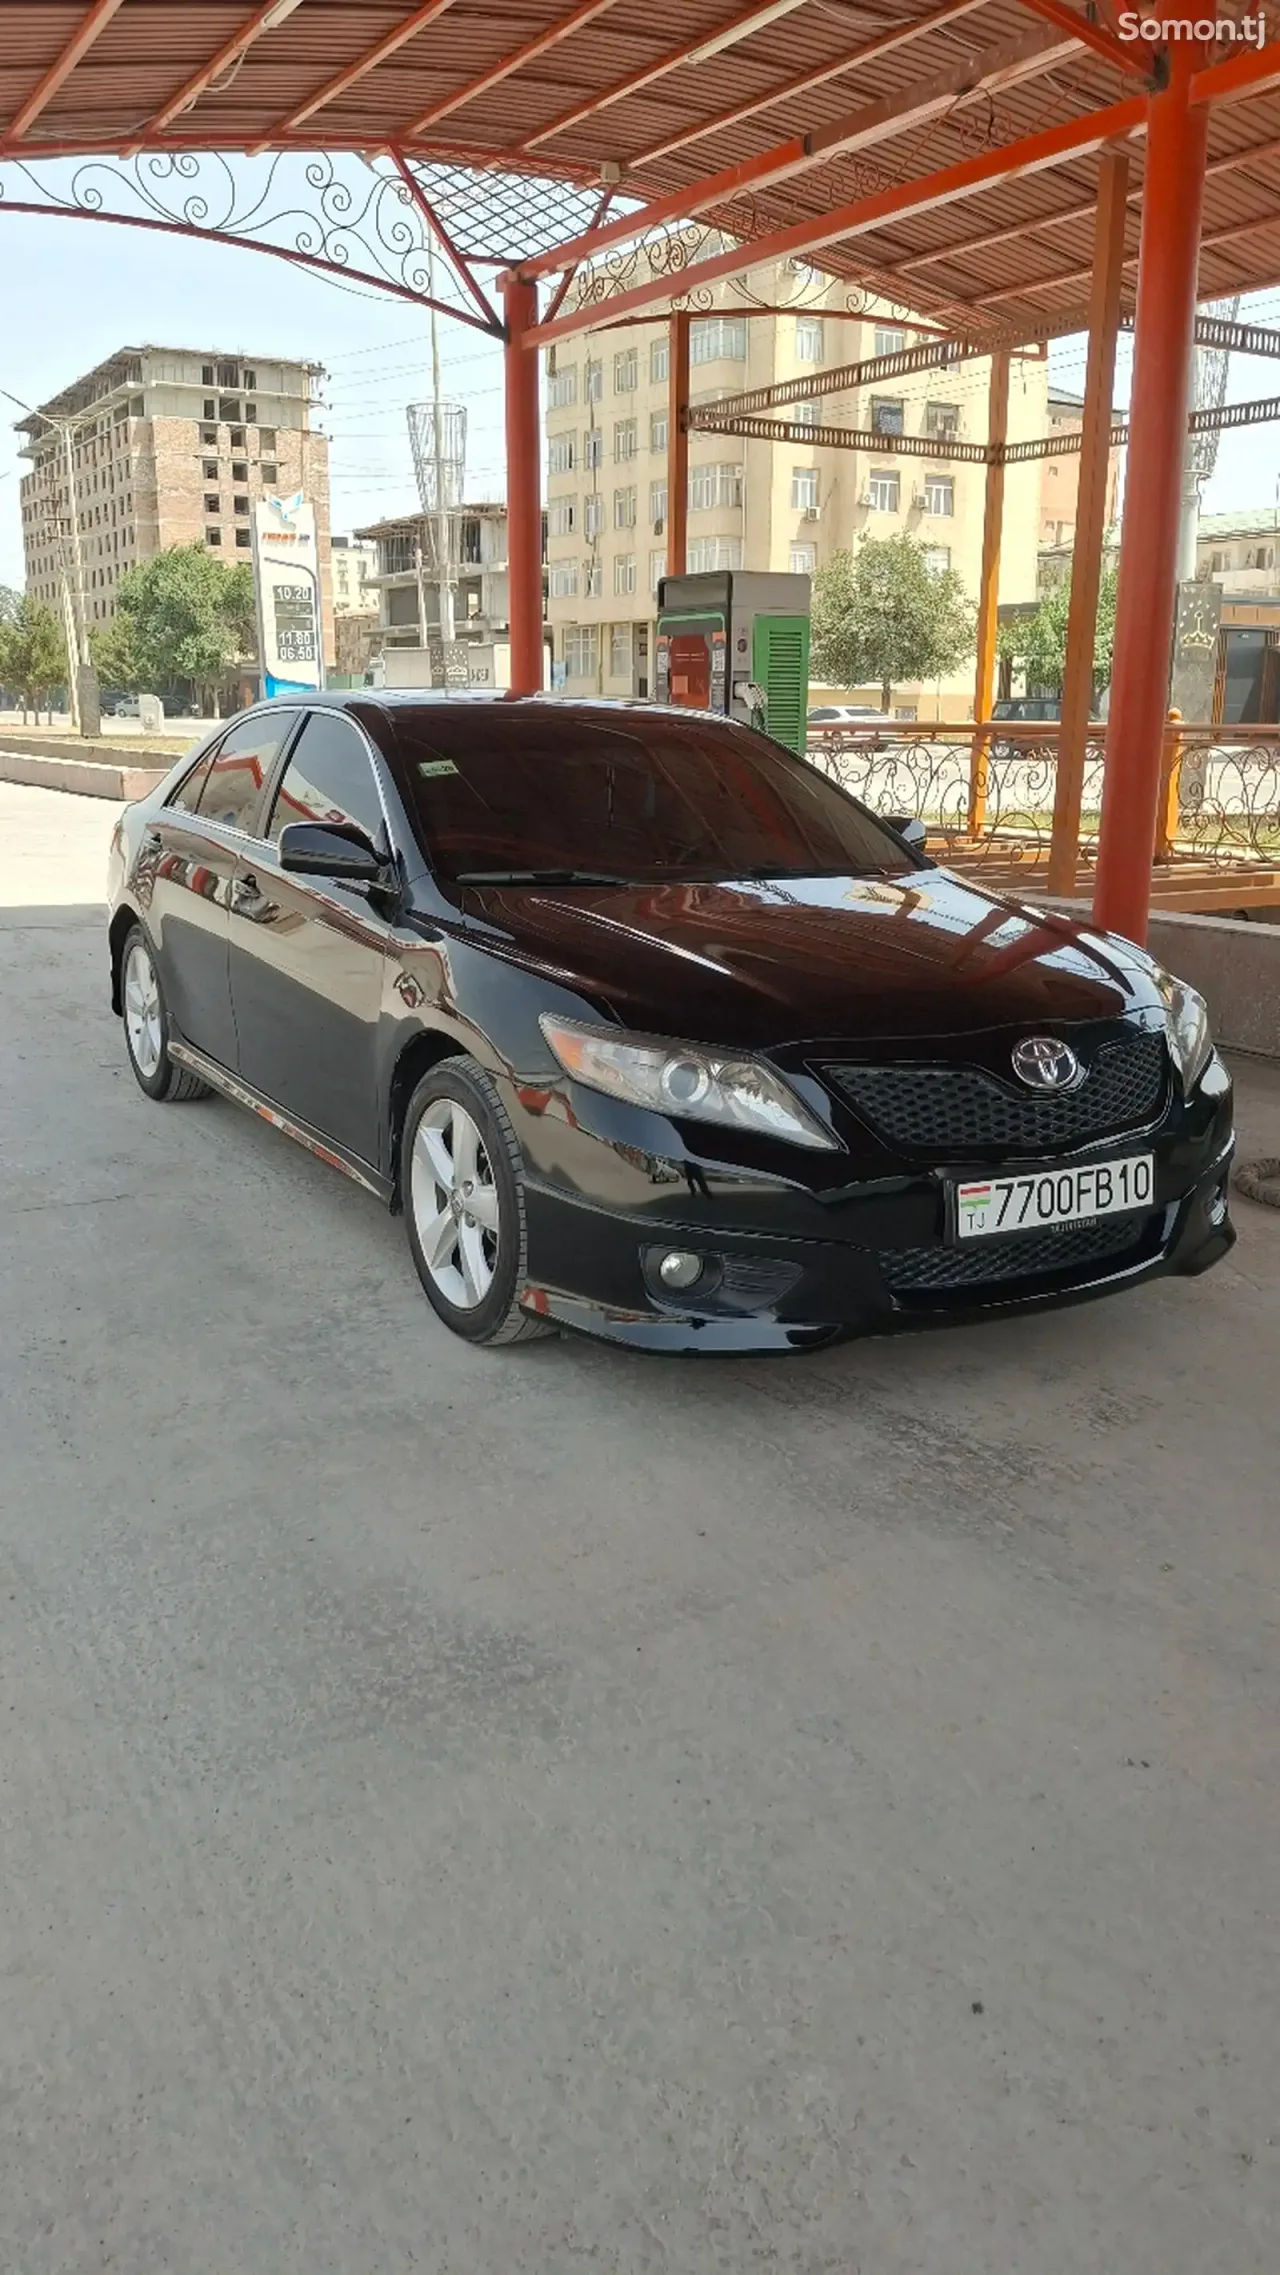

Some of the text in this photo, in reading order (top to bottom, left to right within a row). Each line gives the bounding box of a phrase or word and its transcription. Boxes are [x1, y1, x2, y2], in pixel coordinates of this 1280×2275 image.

[277, 586, 309, 600] 10.20
[278, 631, 310, 645] 11.80
[280, 646, 312, 660] 06.50
[995, 1160, 1150, 1227] 7700FB10
[966, 1212, 985, 1230] TJ
